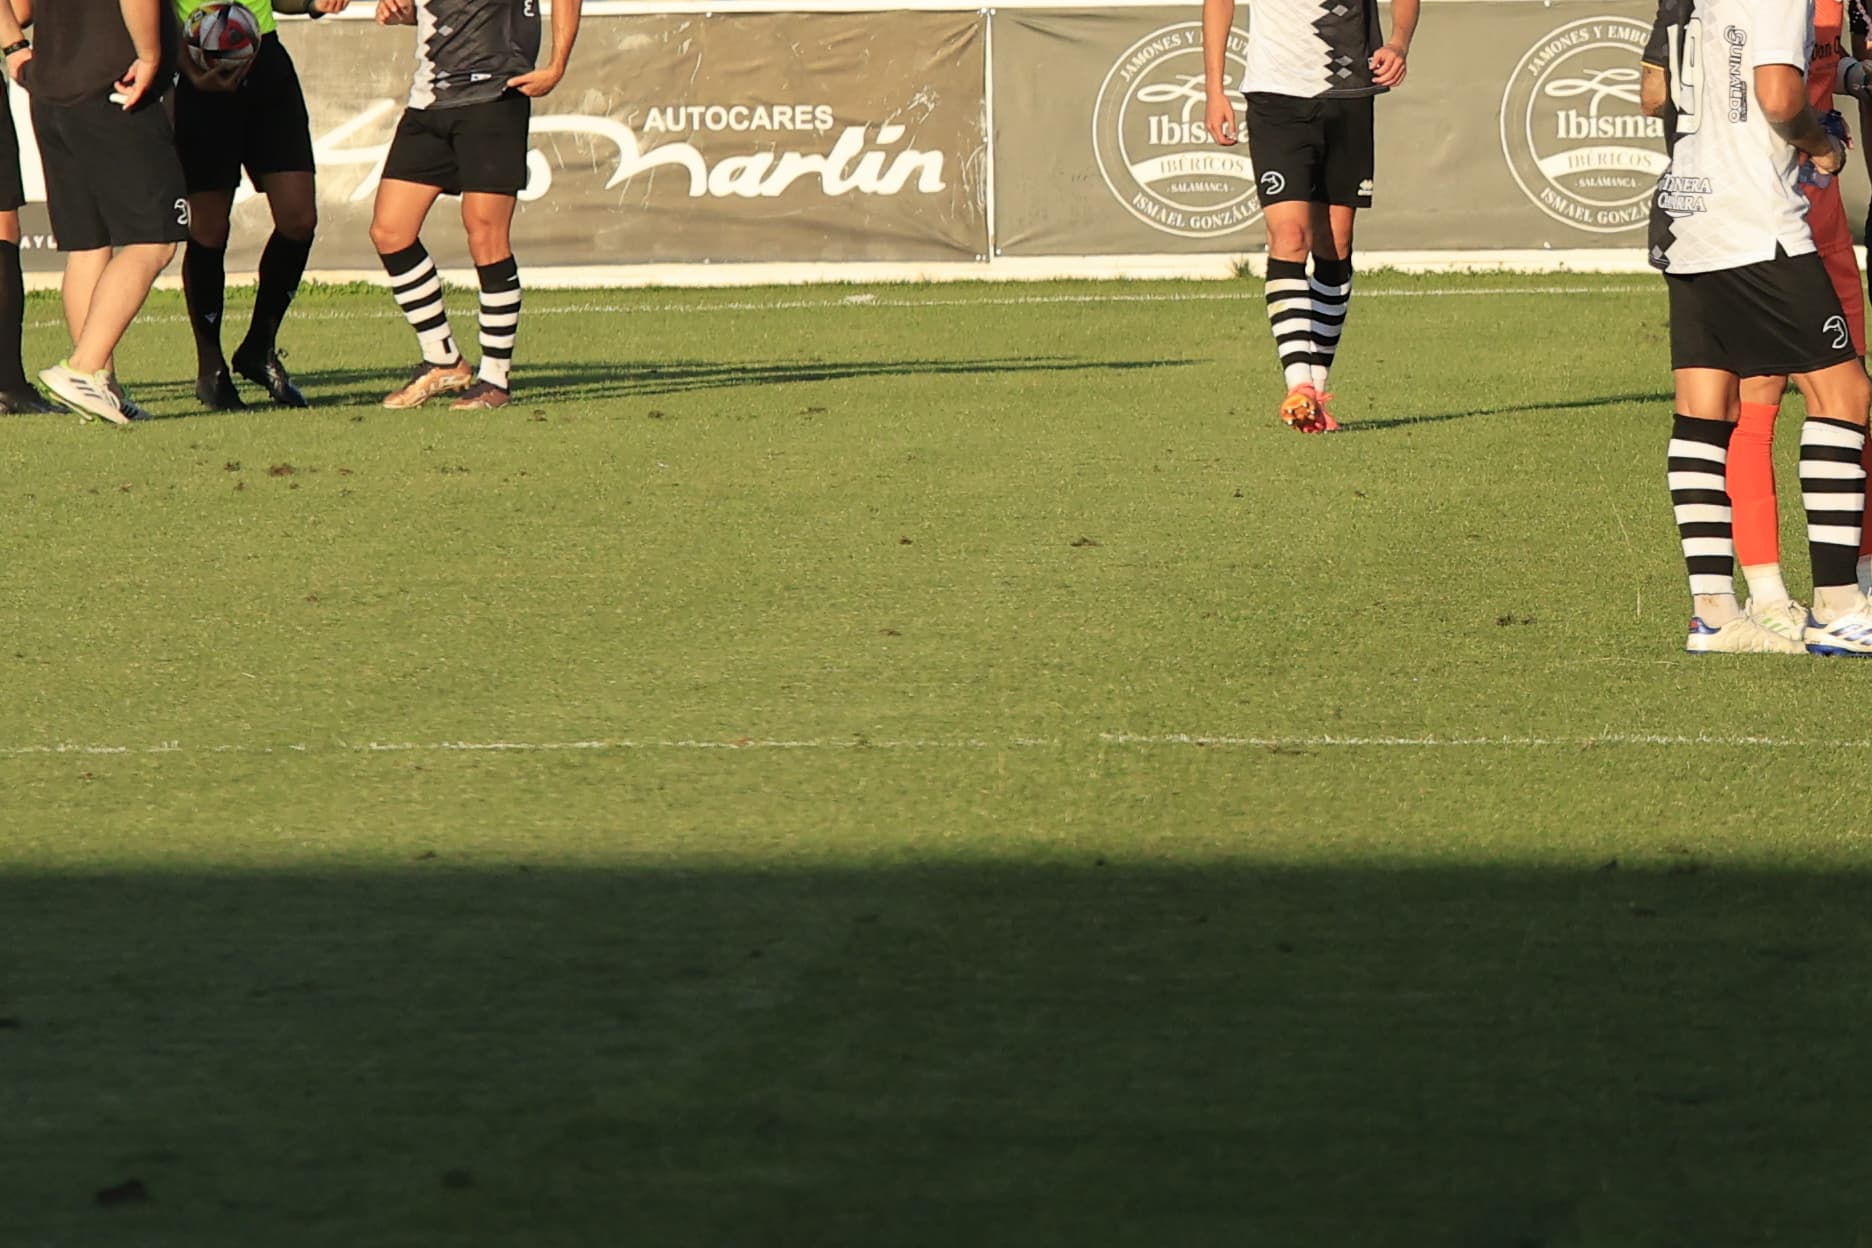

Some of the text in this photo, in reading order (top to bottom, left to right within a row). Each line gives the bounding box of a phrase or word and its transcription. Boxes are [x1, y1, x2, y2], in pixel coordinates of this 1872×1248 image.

[1119, 33, 1182, 83] JAMONES
[1185, 30, 1195, 45] Y
[1527, 24, 1650, 77] JAMONES Y EMBU
[1666, 16, 1706, 135] 19
[643, 104, 834, 133] AUTOCARES
[1148, 114, 1250, 146] Ibisa
[1160, 154, 1245, 173] IBÉRICOS
[1567, 149, 1653, 169] IBÉRICOS
[1170, 182, 1229, 194] SALAMANCA
[1578, 176, 1637, 189] SALAMANCA
[1133, 192, 1261, 230] ISMAEL GONZÁLE
[1540, 186, 1653, 225] ISMAEL GONZÁ
